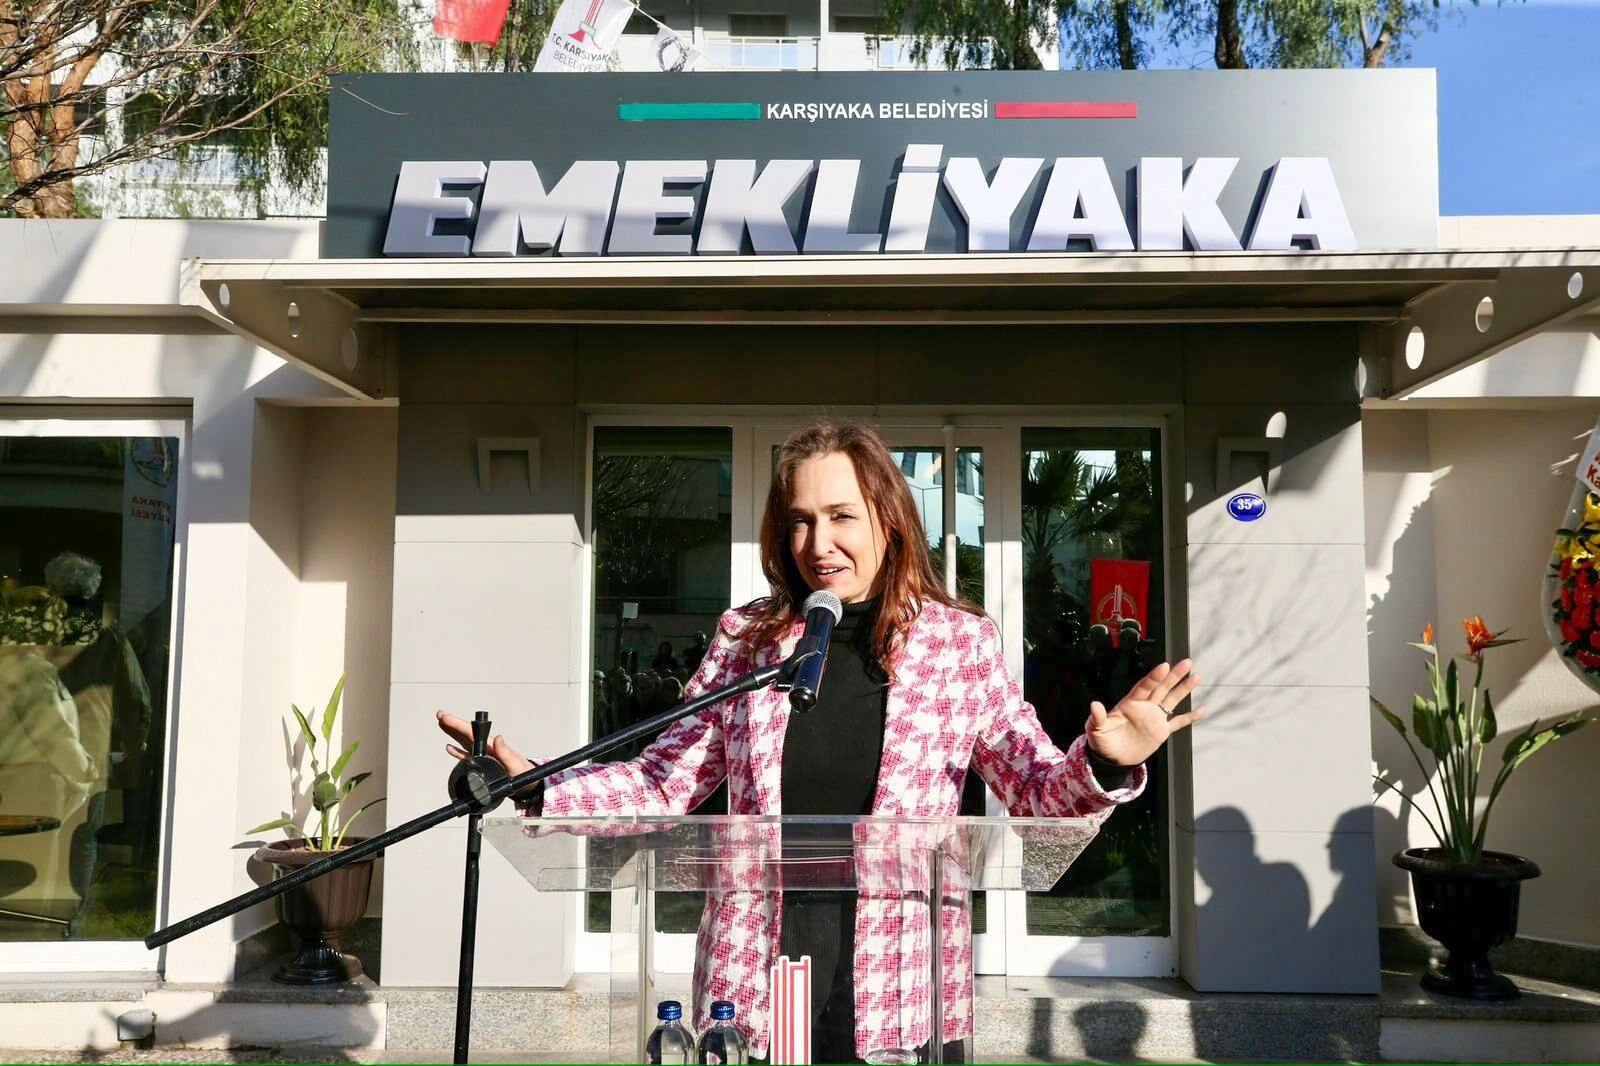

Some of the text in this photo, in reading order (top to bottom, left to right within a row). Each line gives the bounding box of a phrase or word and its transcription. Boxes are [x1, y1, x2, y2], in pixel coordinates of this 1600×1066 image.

[767, 99, 988, 122] KARŞIYAKA BELEDİYESİ
[382, 144, 1360, 256] EMEKLİYAKA
